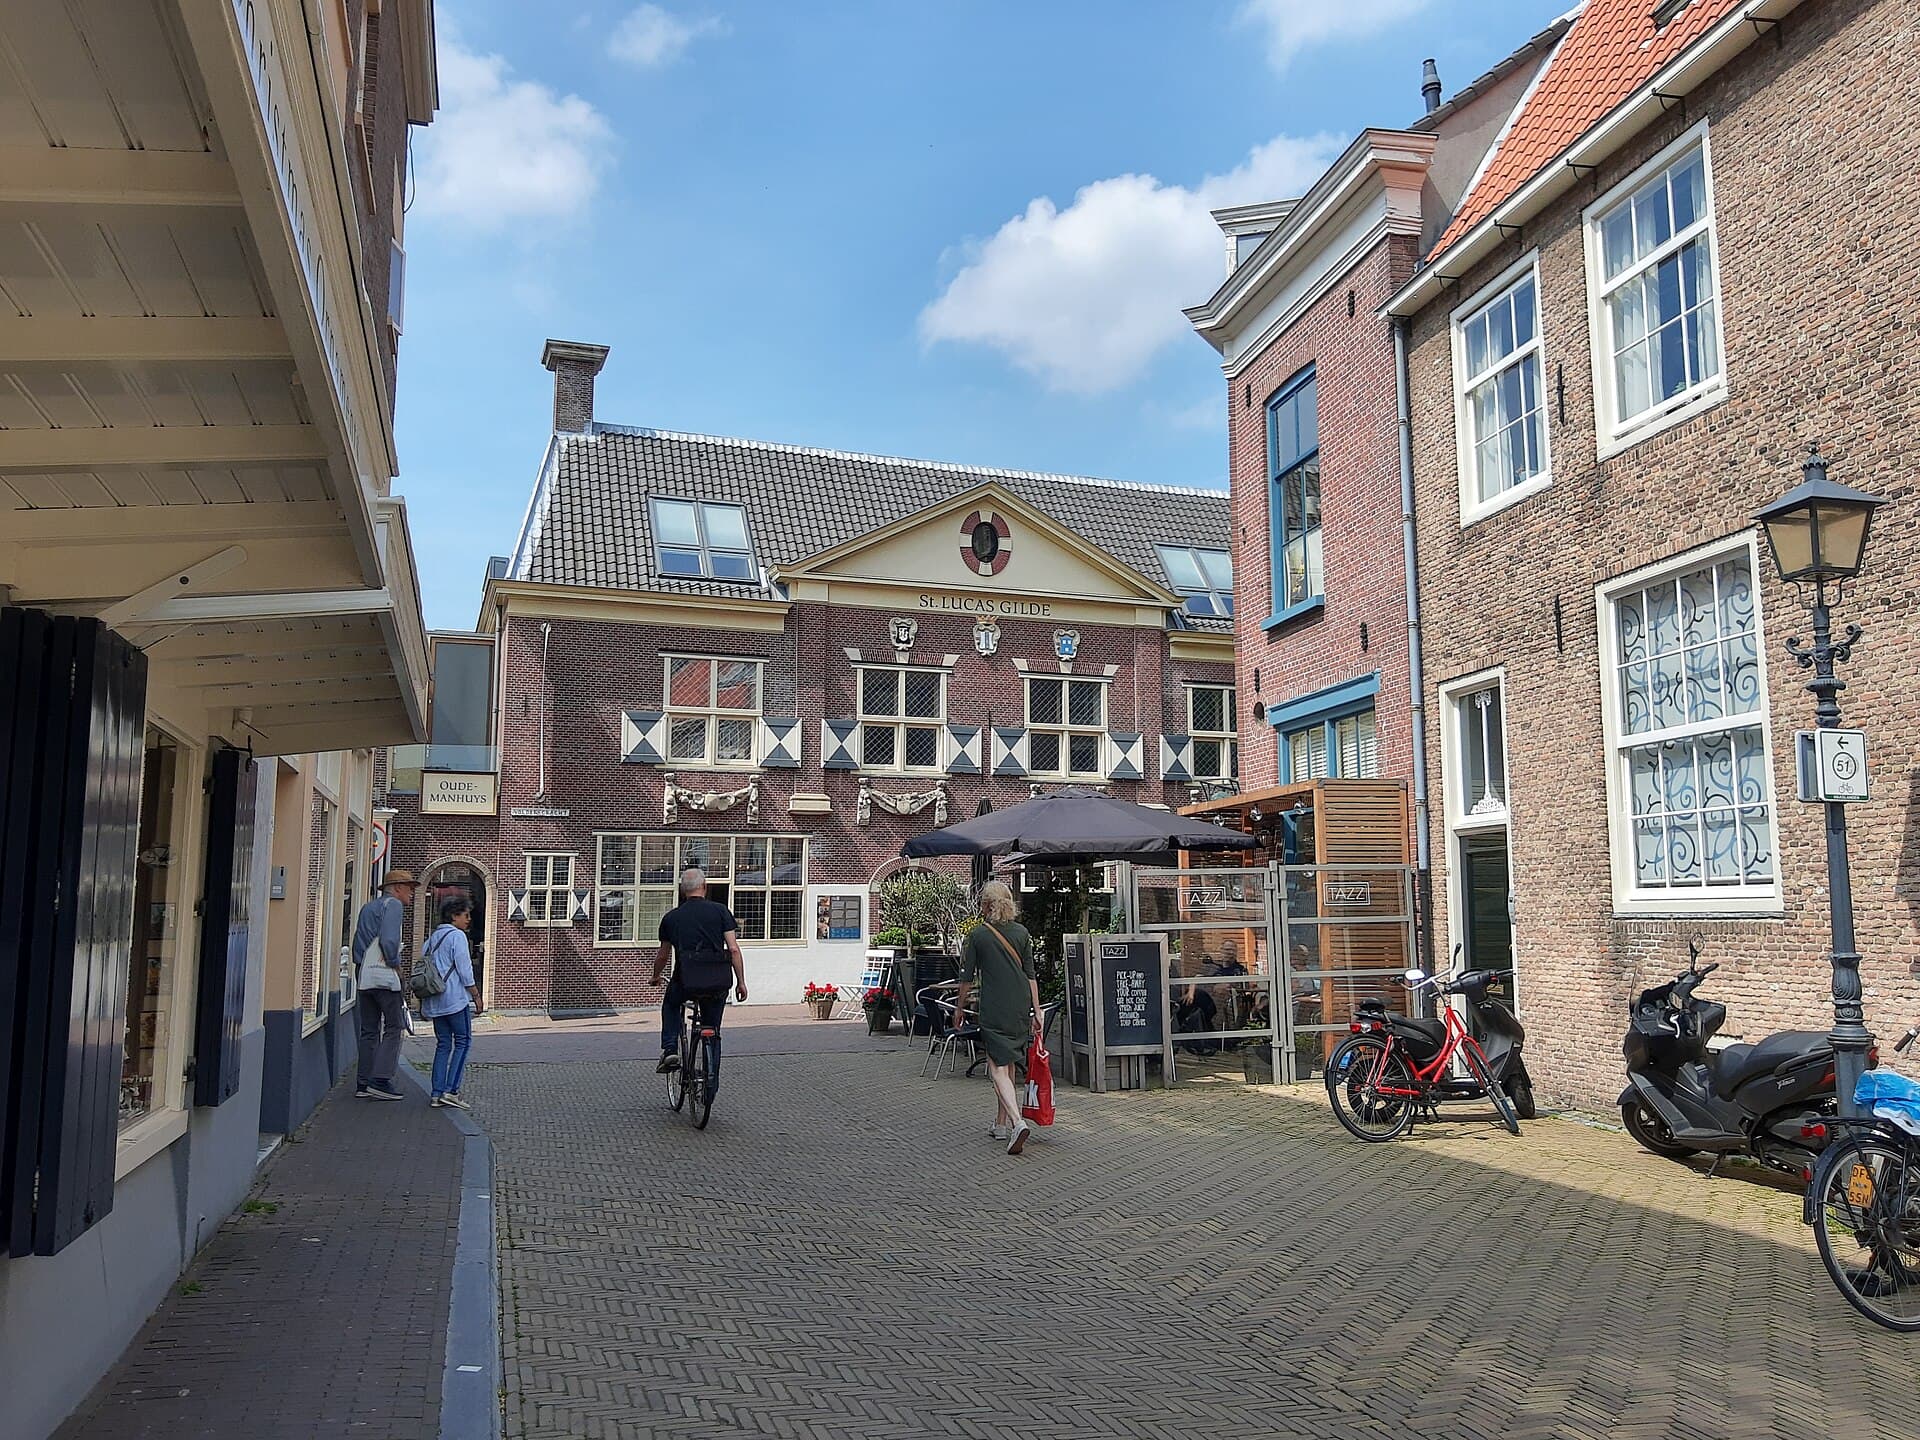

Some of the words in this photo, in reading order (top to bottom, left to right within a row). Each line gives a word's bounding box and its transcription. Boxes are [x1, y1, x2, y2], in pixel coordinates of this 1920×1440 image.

[919, 594, 939, 608] St.
[942, 596, 995, 613] LUCAS
[1000, 600, 1051, 617] GILDE
[1836, 760, 1850, 773] 51
[439, 780, 478, 791] OUDE-
[430, 793, 487, 804] MANHUYS
[1182, 890, 1221, 905] TAZZ
[1328, 887, 1365, 900] TAZZ
[1104, 947, 1125, 956] TAZZ
